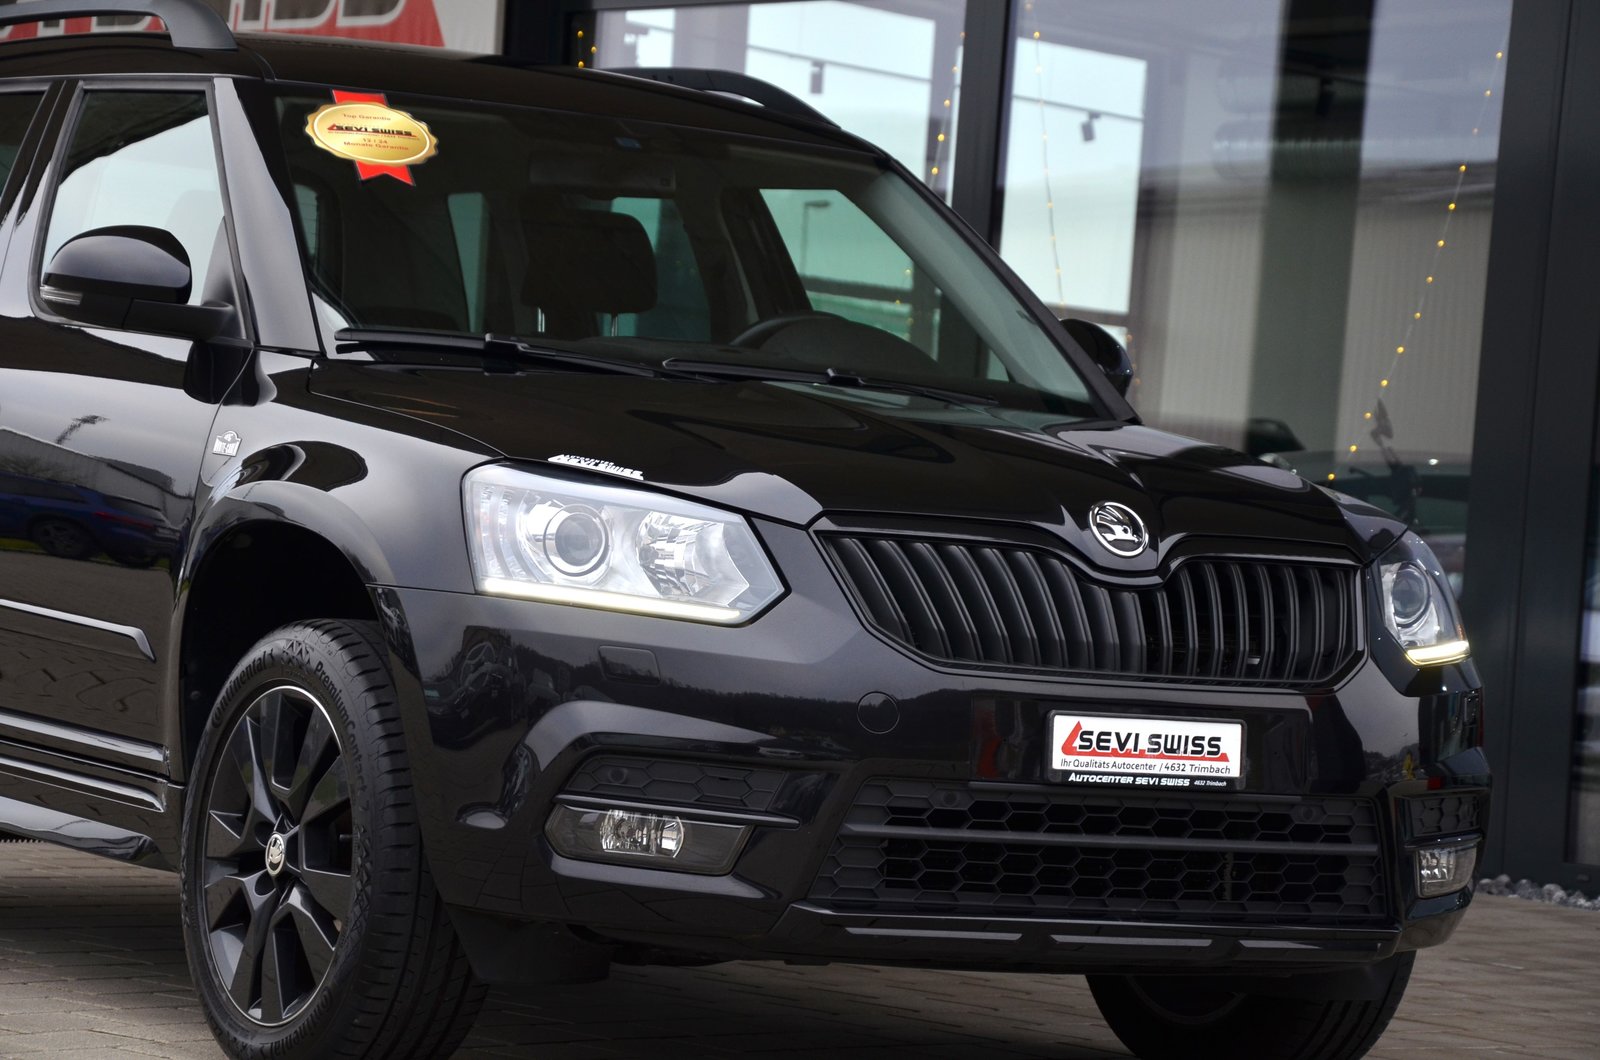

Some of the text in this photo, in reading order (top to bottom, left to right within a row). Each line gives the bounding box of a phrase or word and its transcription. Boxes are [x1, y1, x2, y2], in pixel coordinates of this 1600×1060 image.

[371, 127, 413, 136] SWISS
[211, 650, 267, 729] Continental
[315, 660, 367, 793] PremiumContact
[1078, 730, 1222, 756] SEVI SWISS
[1060, 758, 1072, 768] Ihr
[1111, 761, 1156, 772] Autocenter
[1164, 762, 1186, 772] 4632
[1189, 764, 1231, 775] Trimbach
[1068, 772, 1133, 785] AUTOCENTER
[1135, 776, 1158, 785] SEVI
[1160, 777, 1190, 787] SWISS
